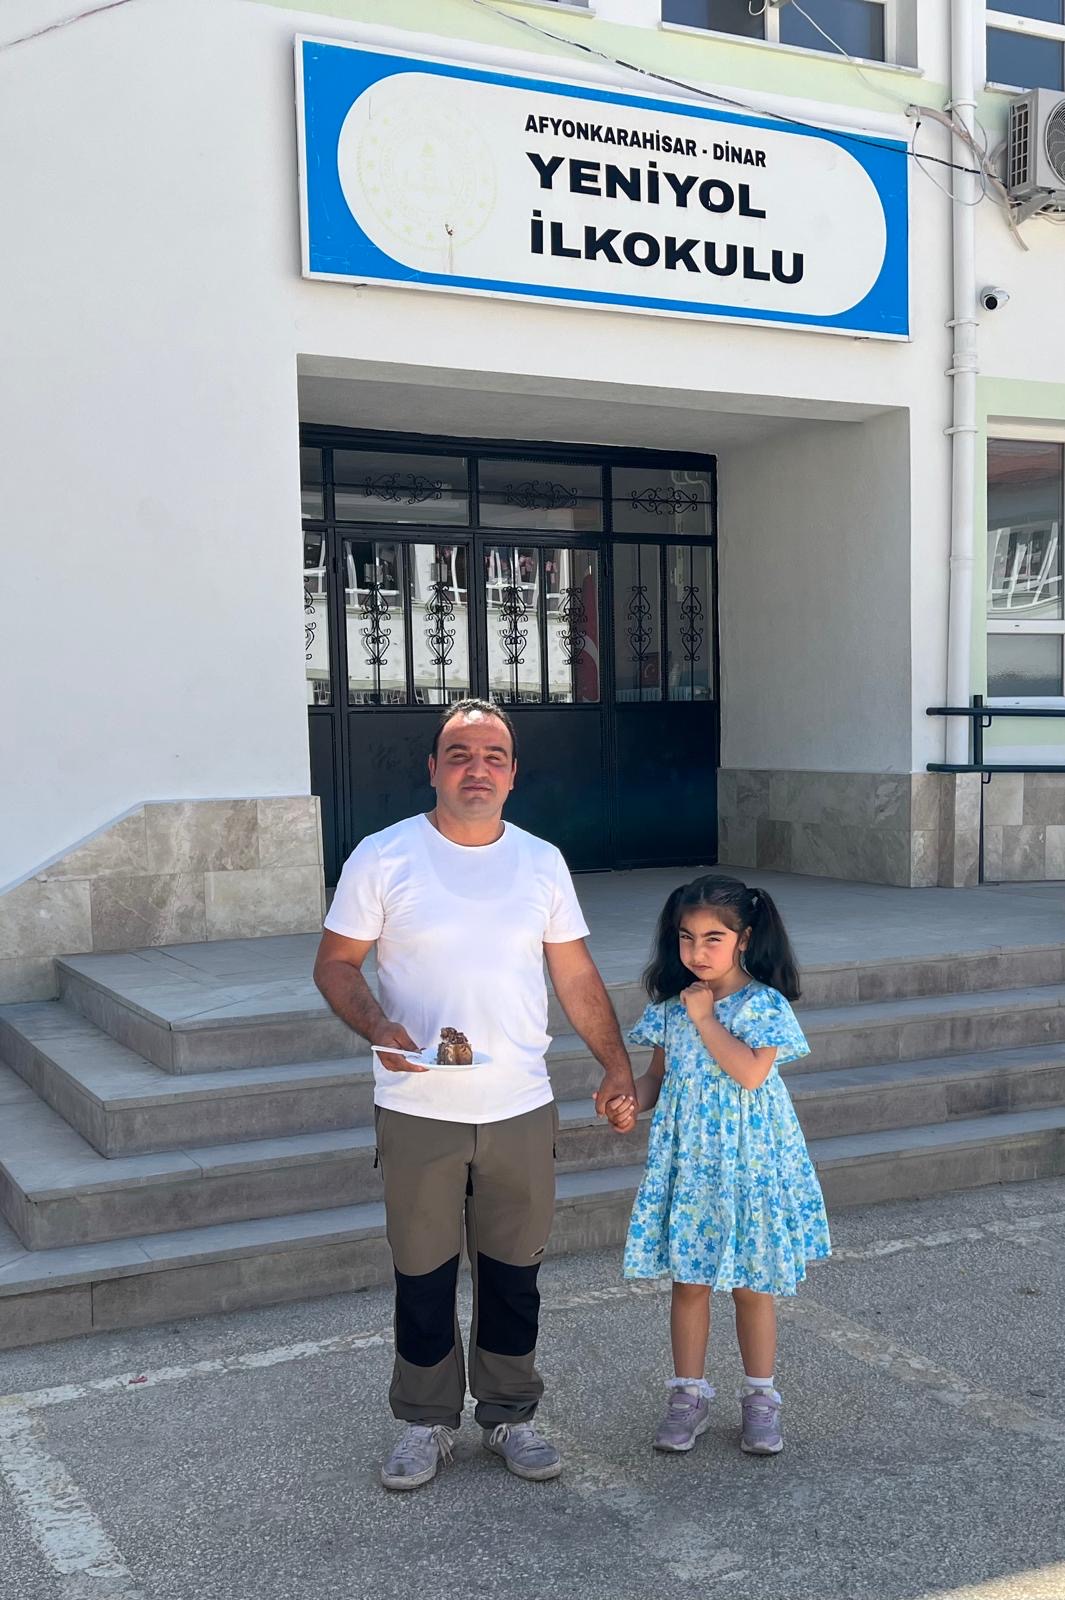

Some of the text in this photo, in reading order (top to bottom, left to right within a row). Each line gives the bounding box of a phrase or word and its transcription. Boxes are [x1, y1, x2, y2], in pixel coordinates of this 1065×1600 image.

[524, 114, 697, 157] AFYONKARAHİSAR
[712, 141, 767, 168] DİNAR
[526, 151, 767, 220] YENİYOL
[530, 209, 804, 285] İLKOKULU
